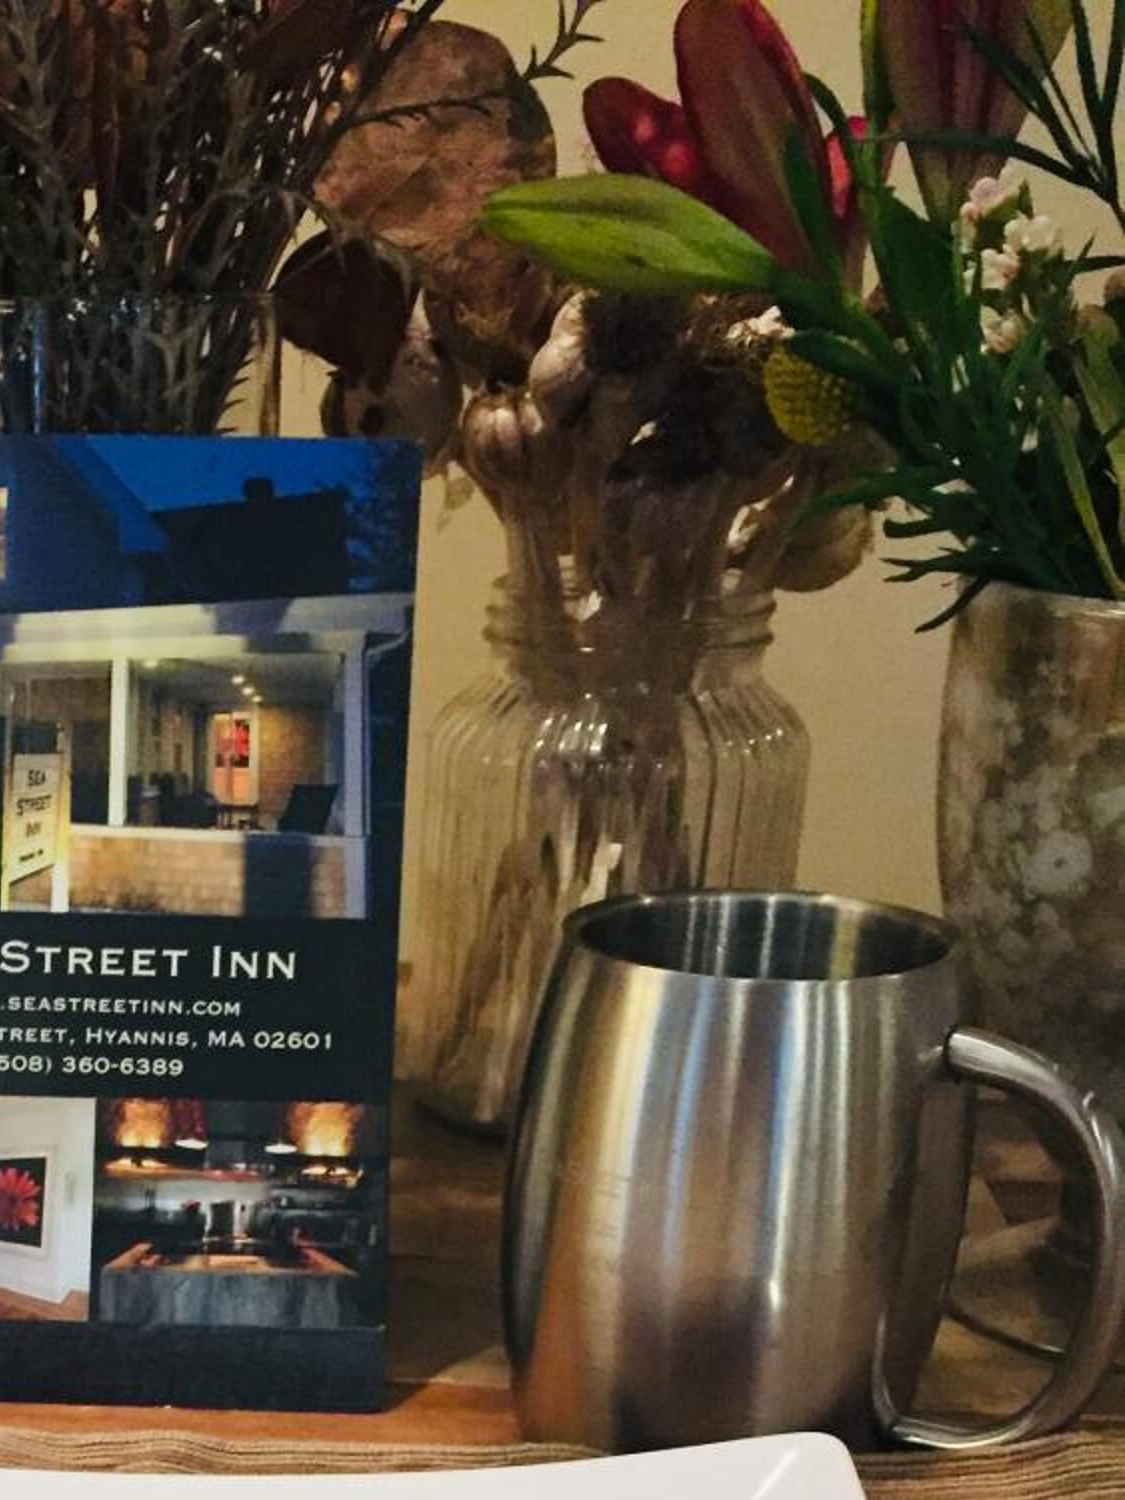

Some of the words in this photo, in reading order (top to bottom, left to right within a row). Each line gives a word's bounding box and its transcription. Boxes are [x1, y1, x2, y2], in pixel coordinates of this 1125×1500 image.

[212, 945, 296, 980] INN
[85, 1027, 198, 1048] HYANNIS,
[207, 1030, 246, 1048] MA
[253, 1030, 332, 1050] 02601
[62, 1055, 184, 1076] 360-6389
